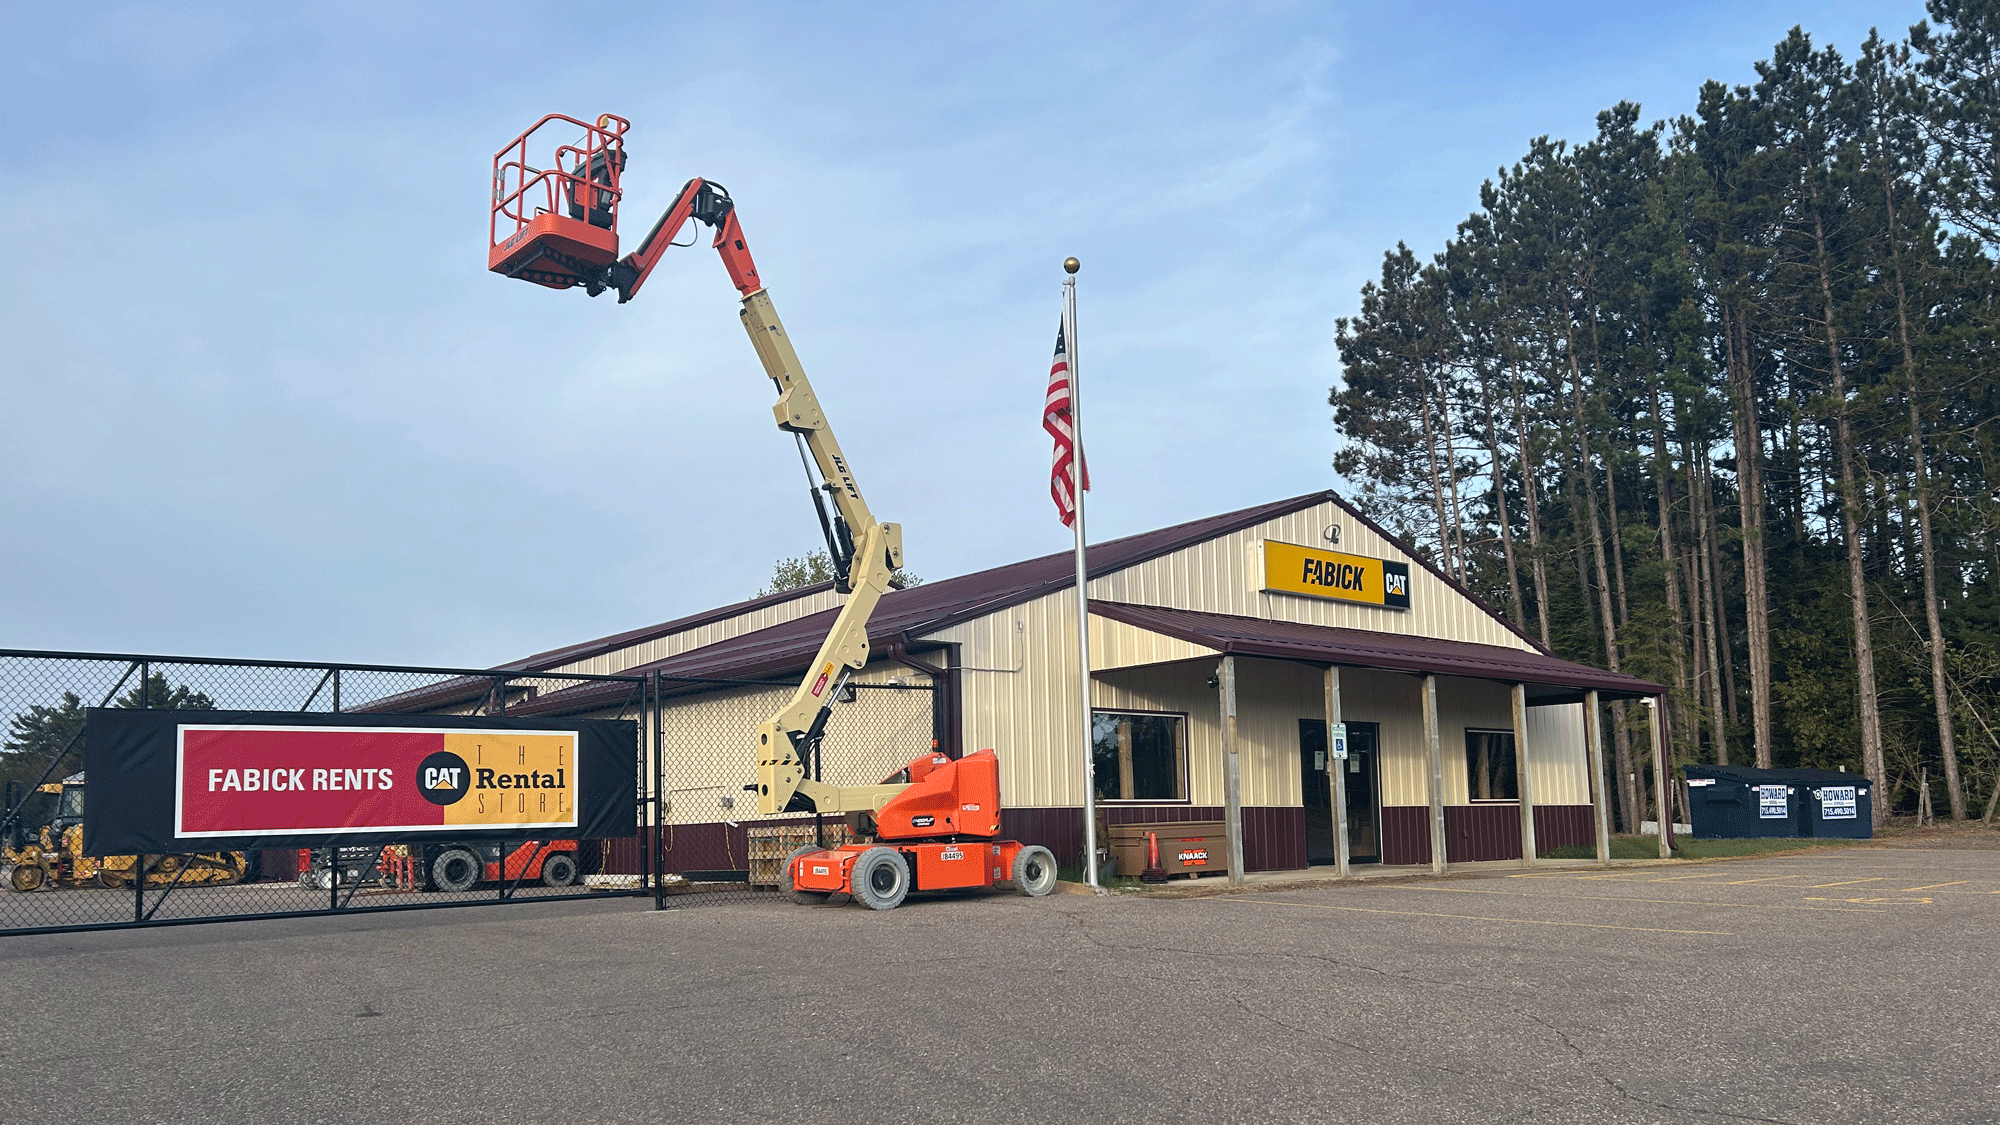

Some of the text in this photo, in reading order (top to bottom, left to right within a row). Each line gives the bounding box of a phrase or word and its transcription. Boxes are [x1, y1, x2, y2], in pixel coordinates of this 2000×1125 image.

[832, 454, 859, 499] JLG LIFT
[1302, 558, 1365, 591] FABICK
[1385, 573, 1406, 596] CAT
[477, 745, 564, 766] THE
[208, 768, 393, 792] FABICK RENTS
[424, 767, 462, 790] CAT
[475, 768, 566, 789] Rental
[478, 793, 564, 814] STORE
[1761, 788, 1786, 799] HOWARD
[1823, 790, 1854, 801] HOWARD
[1178, 852, 1208, 860] KNAACK
